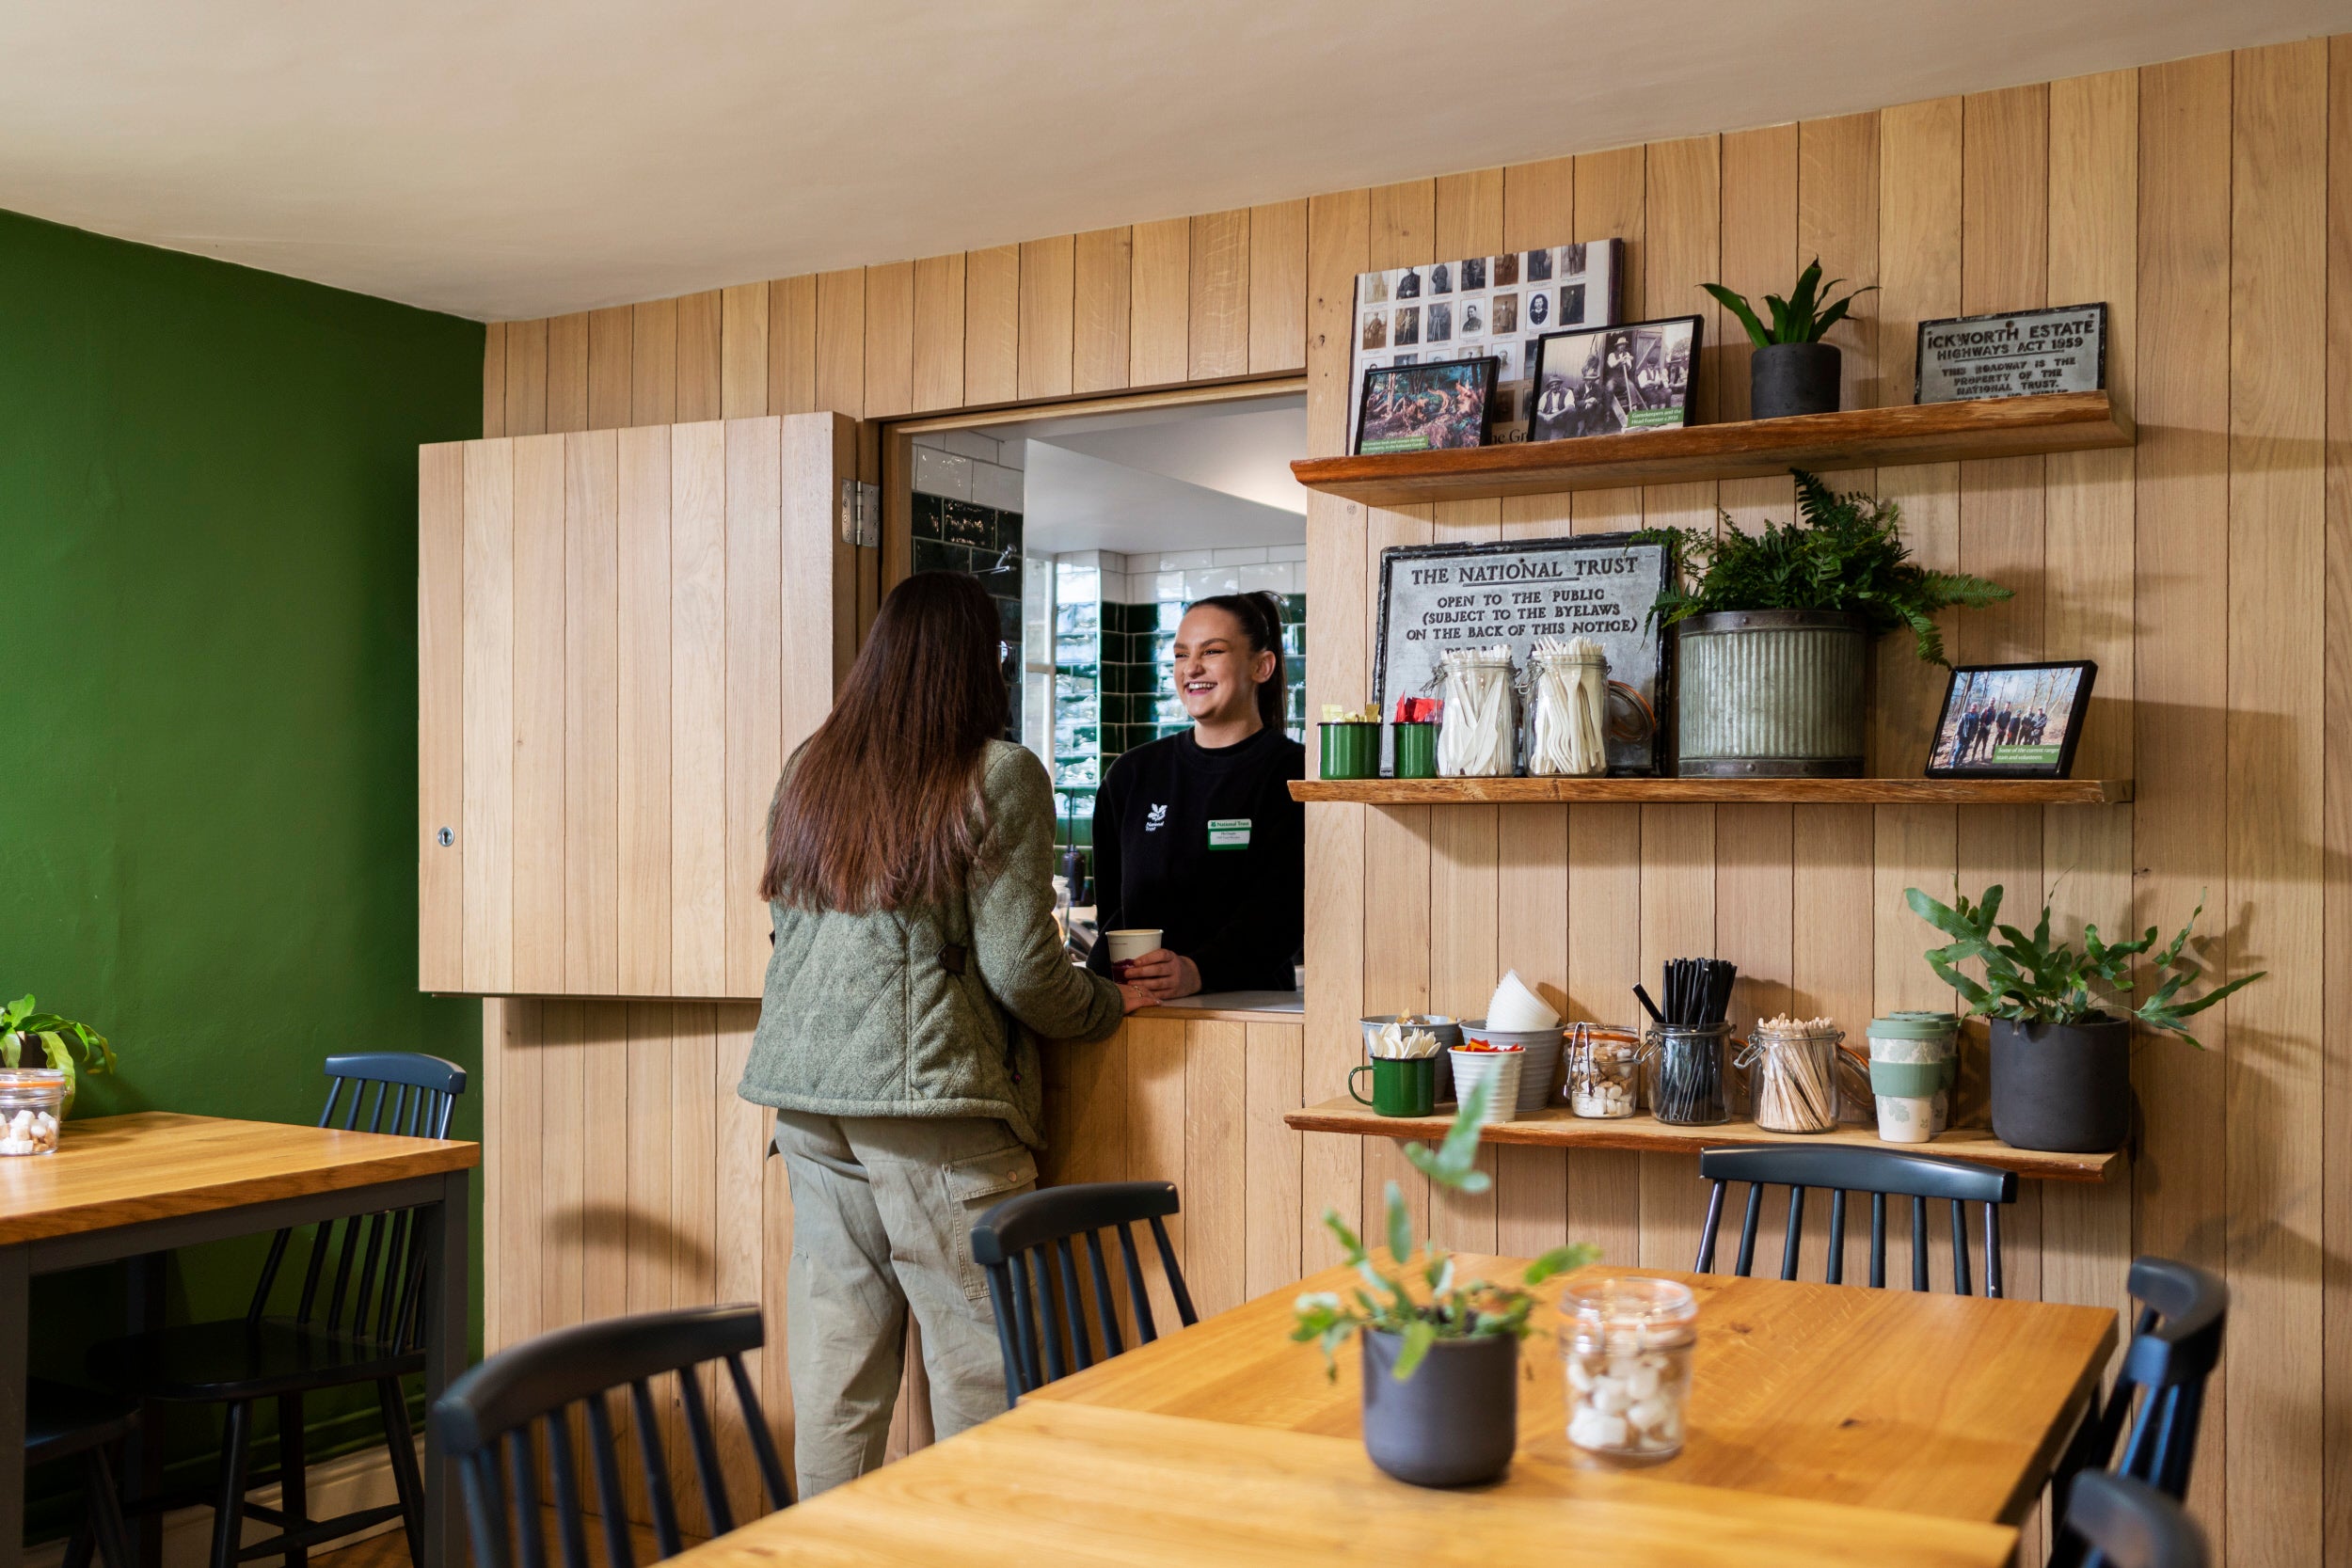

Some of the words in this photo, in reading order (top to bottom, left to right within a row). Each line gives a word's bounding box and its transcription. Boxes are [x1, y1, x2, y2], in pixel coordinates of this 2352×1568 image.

[1928, 327, 2019, 349] ICKWORTH
[2030, 321, 2094, 339] ESTATE
[1937, 344, 2009, 360] HIGHWAYS
[2017, 341, 2045, 353] ACT
[2052, 337, 2083, 349] 1959
[1942, 367, 1966, 376] THIS
[1976, 361, 2027, 373] ROADWAY
[2054, 357, 2075, 366] THE
[1954, 373, 2010, 386] PROPERTY
[2019, 371, 2032, 379] OF
[2041, 369, 2062, 377] THE
[1957, 384, 2012, 395] NATIONAL
[2021, 379, 2058, 389] TRUST.
[1412, 567, 1449, 585] THE
[1458, 562, 1563, 582] NATIONAL
[1574, 557, 1638, 576] TRUST
[1438, 594, 1475, 609] OPEN
[1484, 594, 1502, 606] TO
[1512, 592, 1541, 604] THE
[1552, 589, 1604, 602] PUBLIC
[1422, 610, 1485, 626] (SUBJECT
[1492, 610, 1511, 621] TO
[1518, 607, 1546, 619] THE
[1554, 603, 1620, 617] BYELAWS
[1406, 629, 1426, 641] ON
[1433, 627, 1461, 640] THE
[1468, 626, 1503, 638] BACK
[1508, 624, 1526, 636] OF
[1532, 623, 1565, 635] THIS
[1572, 617, 1637, 634] NOTICE)
